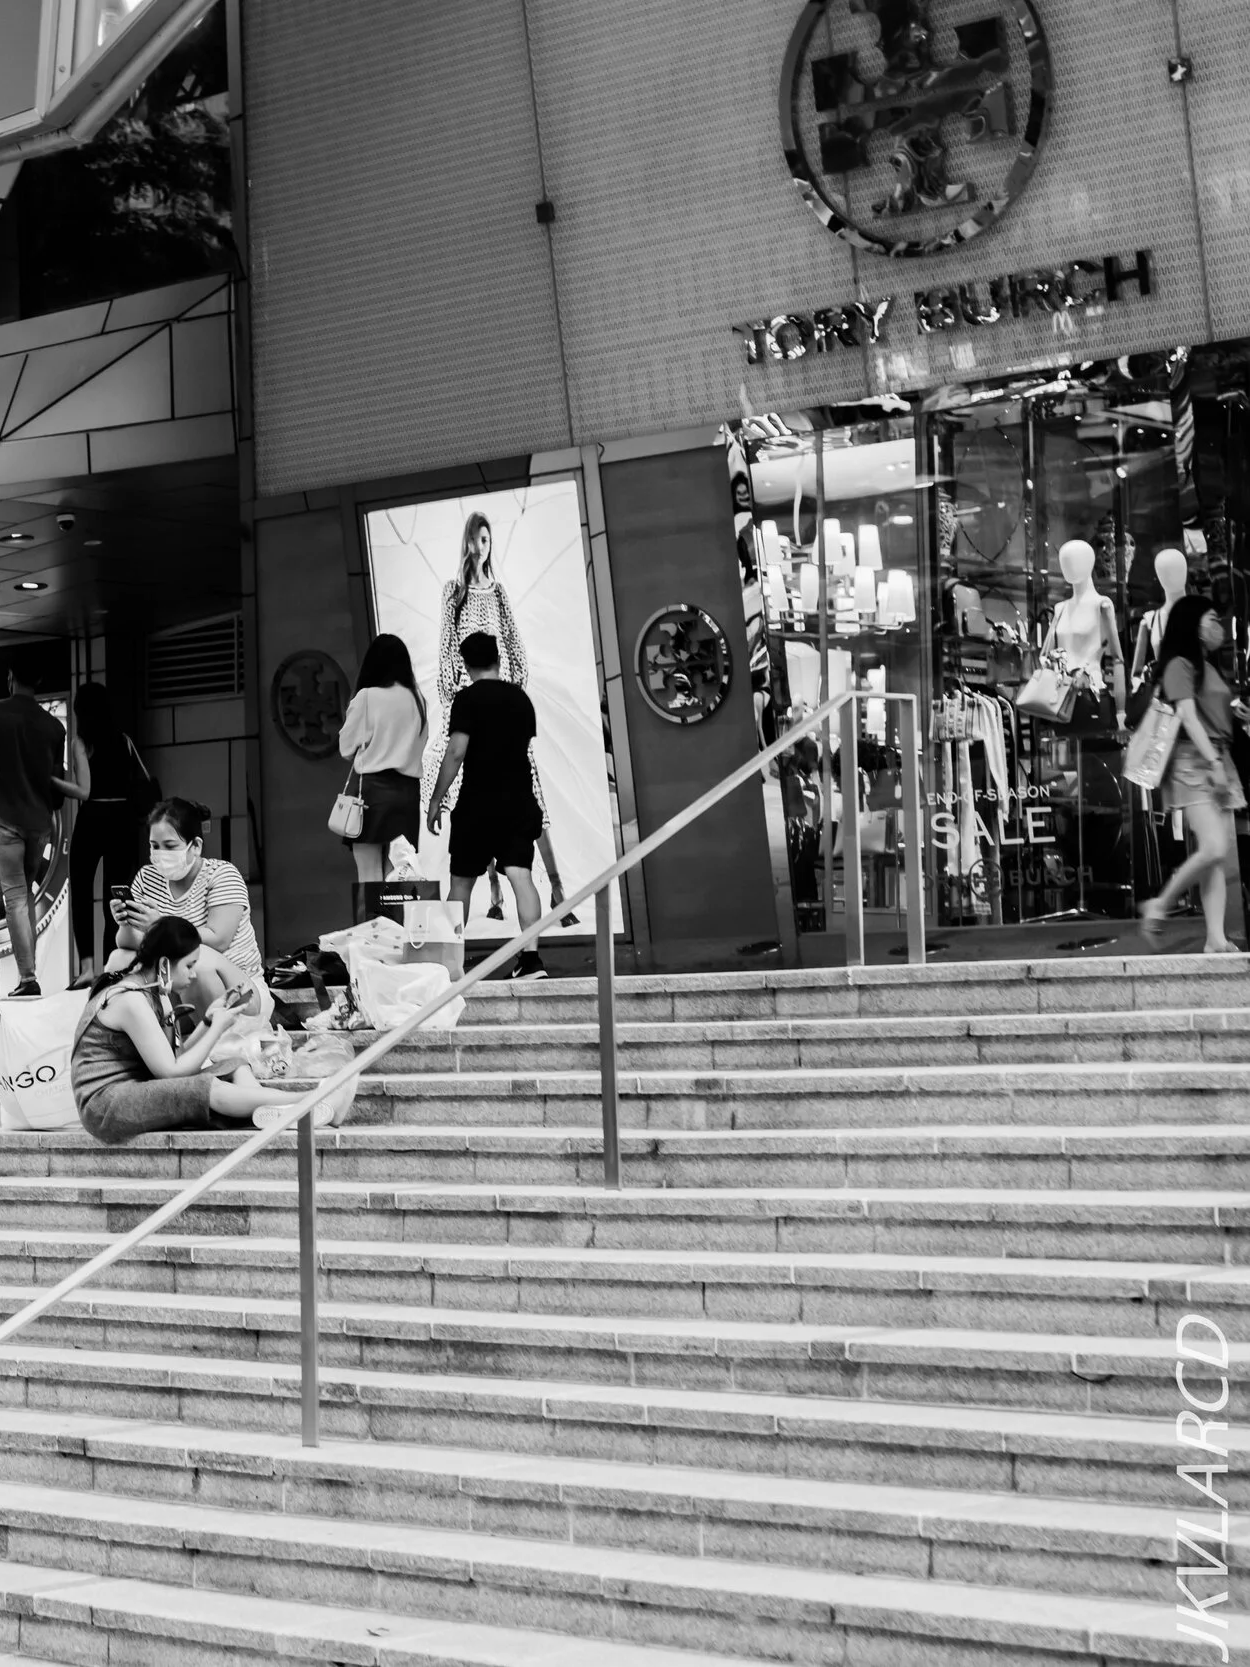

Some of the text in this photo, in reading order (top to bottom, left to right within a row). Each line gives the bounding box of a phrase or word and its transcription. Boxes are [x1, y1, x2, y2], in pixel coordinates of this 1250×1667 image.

[732, 250, 1152, 365] TORY BURCH
[931, 807, 1056, 850] SALE
